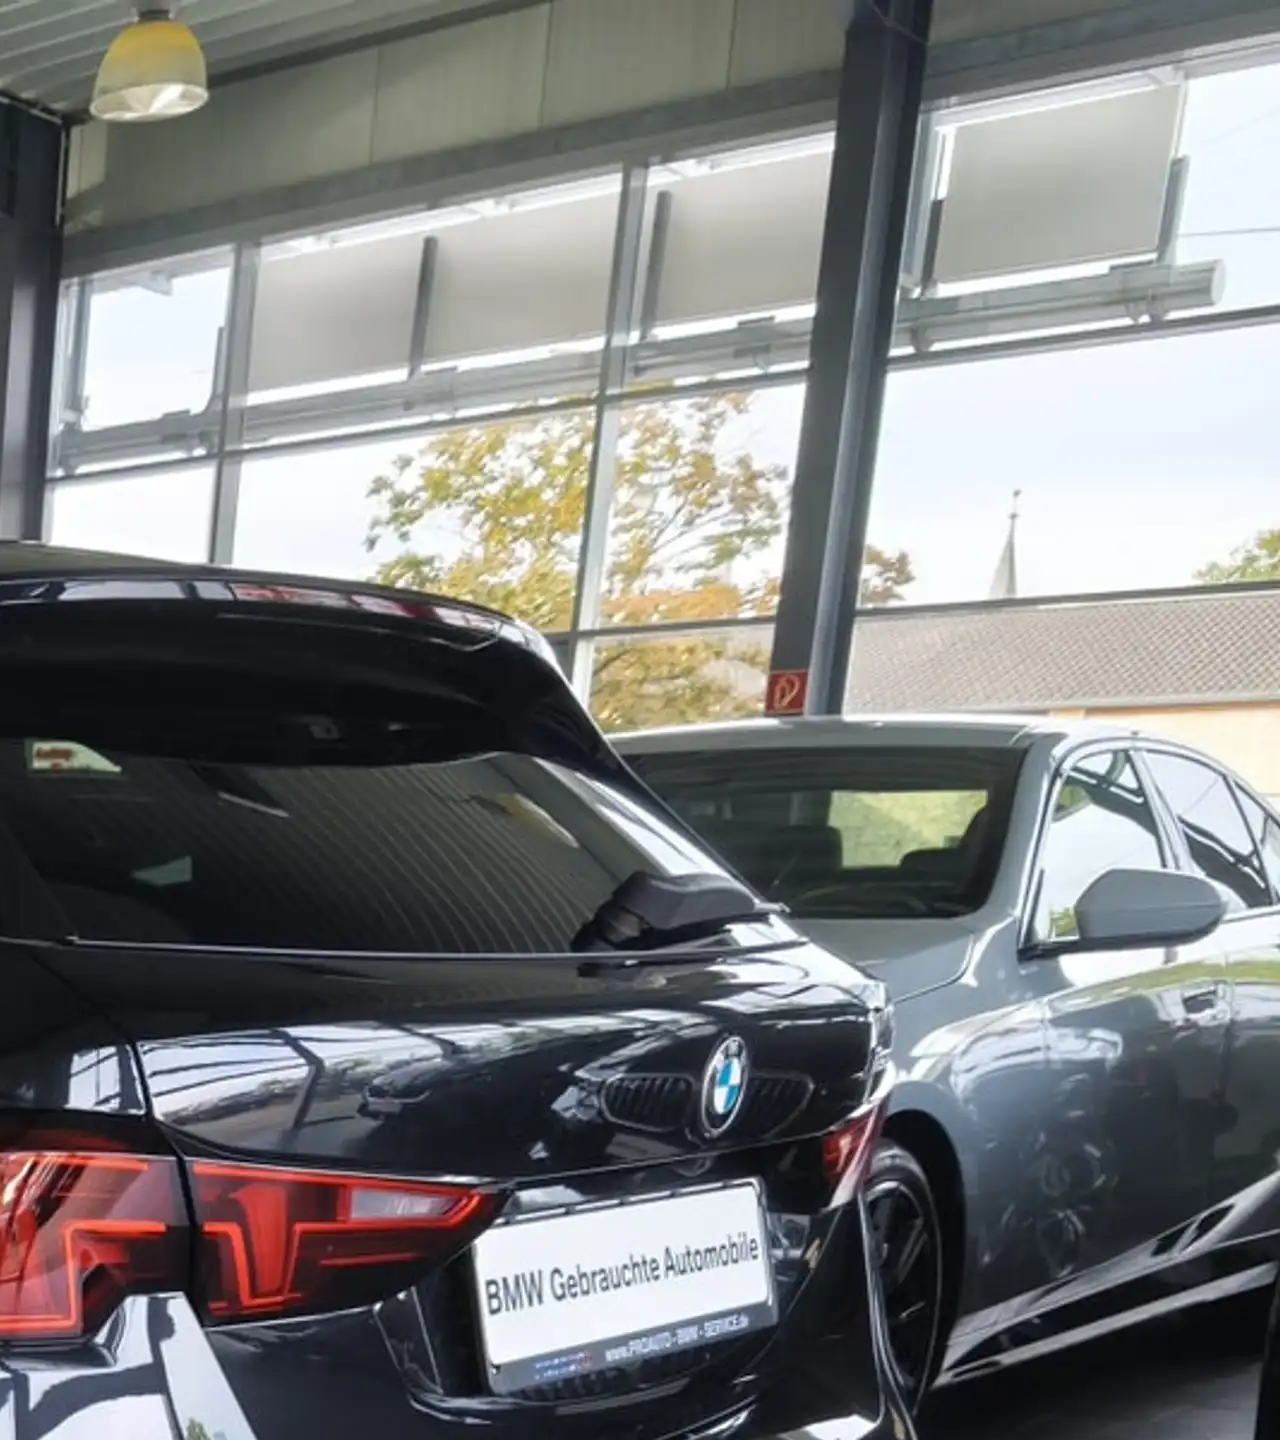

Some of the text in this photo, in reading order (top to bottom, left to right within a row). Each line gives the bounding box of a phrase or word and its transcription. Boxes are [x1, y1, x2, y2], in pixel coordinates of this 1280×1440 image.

[485, 1231, 759, 1316] BMW Gebrauchte Automobile
